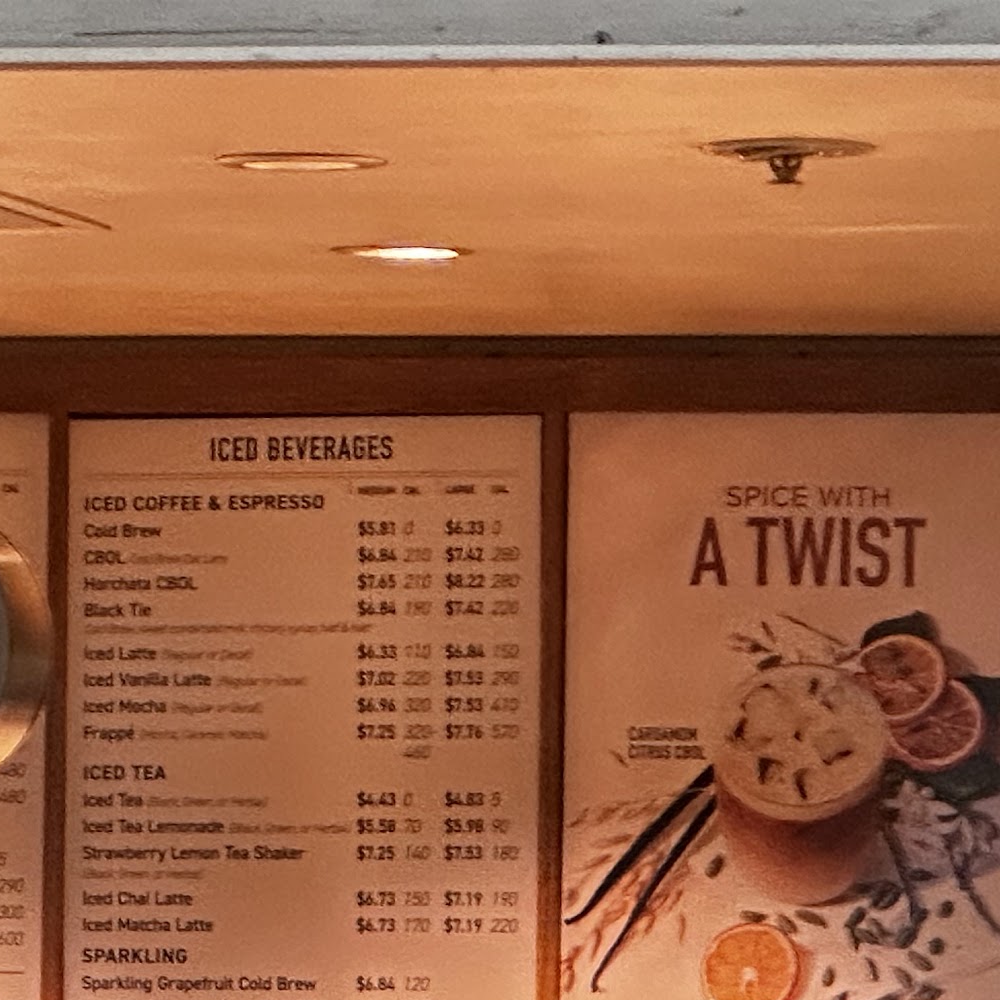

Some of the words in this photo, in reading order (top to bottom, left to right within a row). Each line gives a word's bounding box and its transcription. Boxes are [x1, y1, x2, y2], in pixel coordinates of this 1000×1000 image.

[210, 437, 258, 461] ICED
[268, 436, 394, 460] BEVERAGES
[85, 496, 126, 512] ICED
[133, 496, 203, 511] COFFEE
[208, 496, 221, 510] &
[228, 495, 325, 511] ESPRESSO
[727, 486, 807, 507] SPICE
[818, 486, 891, 507] WITH
[84, 524, 118, 538] Cold
[122, 524, 162, 538] Brew
[689, 516, 728, 587] A
[746, 516, 927, 588] TWIST
[445, 573, 485, 589] $8.22
[84, 603, 124, 617] Black
[129, 603, 152, 617] Tie
[84, 646, 114, 661] Iced
[119, 647, 157, 661] Latte
[84, 672, 114, 687] Iced
[174, 674, 212, 687] Latte
[84, 700, 114, 713] Iced
[119, 700, 167, 713] Mocha
[84, 765, 125, 781] ICED
[131, 765, 166, 780] TEA
[83, 794, 113, 808] Iced
[117, 793, 143, 807] Tea
[83, 820, 113, 834] Iced
[117, 820, 143, 834] Tea
[82, 846, 166, 863] Strawberry
[171, 848, 219, 860] Lemon
[224, 846, 249, 860] Tea
[356, 844, 395, 861] $7.25
[83, 891, 113, 905] Iced
[118, 891, 150, 905] Chai
[155, 891, 193, 905] Latte
[356, 890, 395, 907] $6.73
[444, 890, 484, 907] $7.19
[83, 918, 113, 932] Iced
[118, 918, 171, 932] Matcha
[176, 919, 214, 932] Latte
[356, 916, 395, 934] $6.73
[444, 916, 484, 934] $7.19
[82, 948, 188, 964] SPARKLING
[81, 975, 152, 993] Sparkling
[158, 975, 233, 992] Grapefruit
[238, 976, 272, 990] Cold
[277, 977, 316, 990] Brew
[356, 975, 395, 992] $6.84
